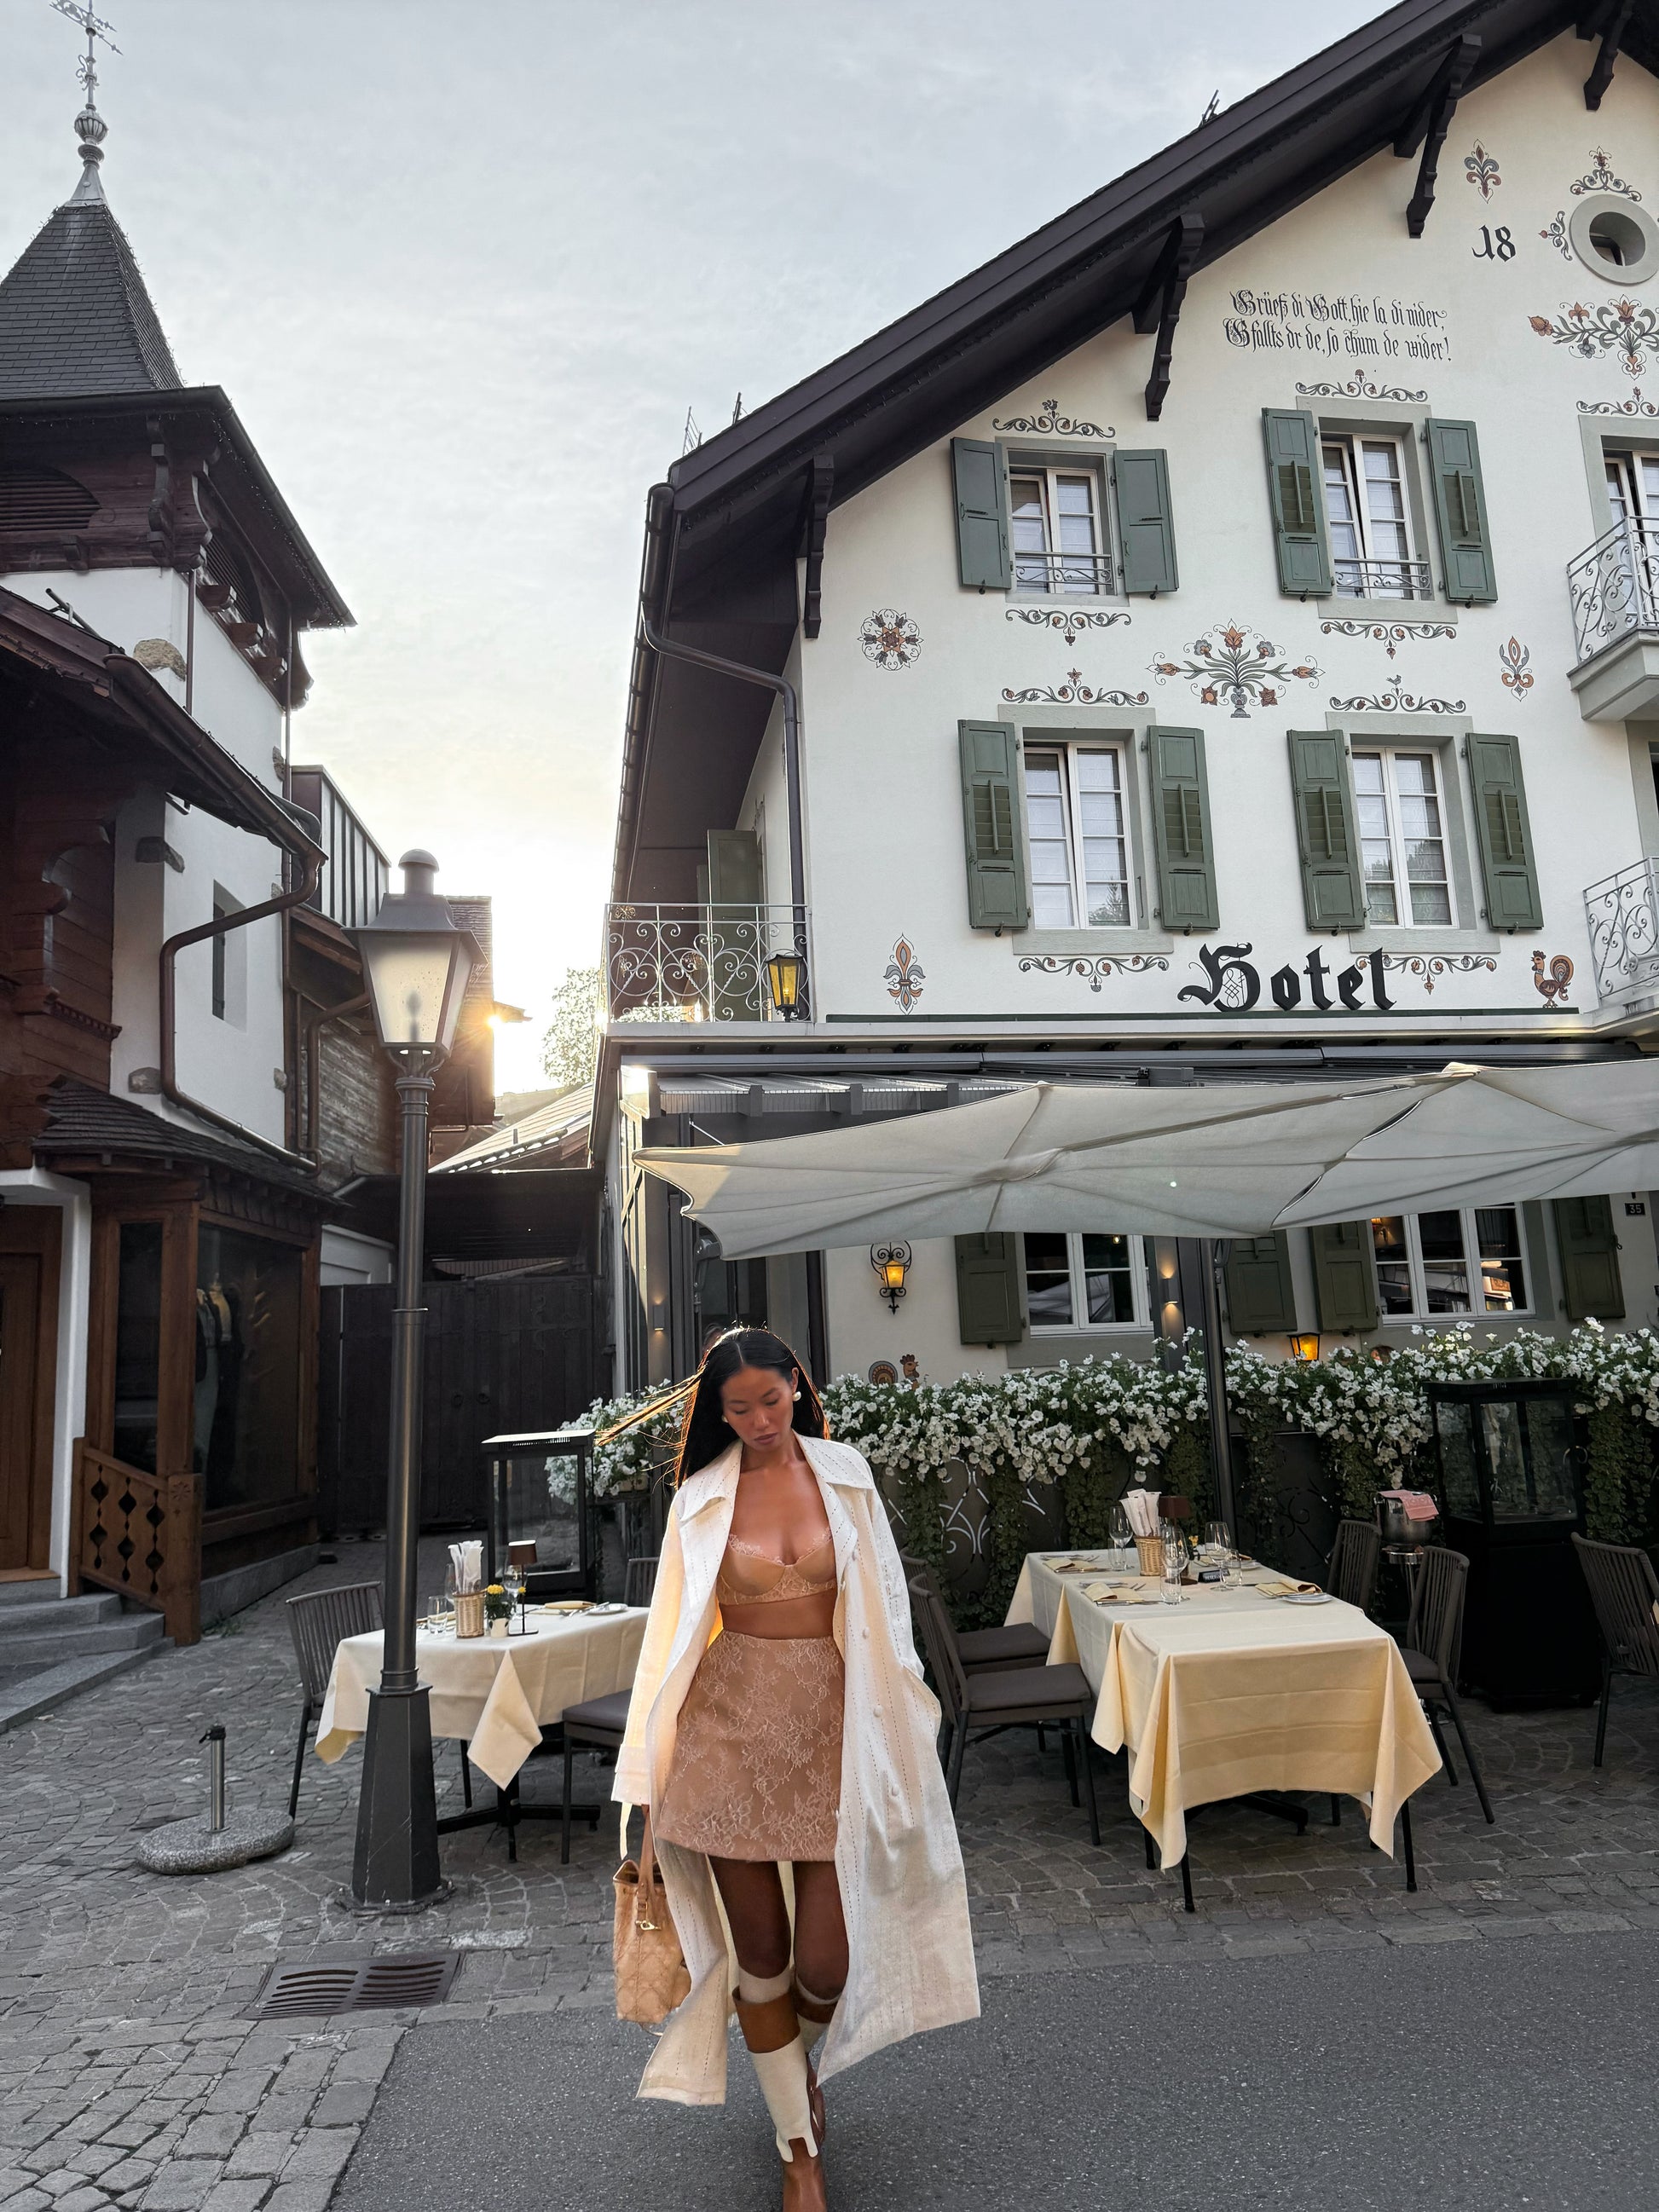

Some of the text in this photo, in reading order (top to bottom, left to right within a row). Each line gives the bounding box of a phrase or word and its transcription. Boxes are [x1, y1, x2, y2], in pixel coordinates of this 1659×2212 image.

[1471, 224, 1516, 263] 18
[1176, 942, 1397, 1012] Hotel
[1629, 1204, 1642, 1214] 35
